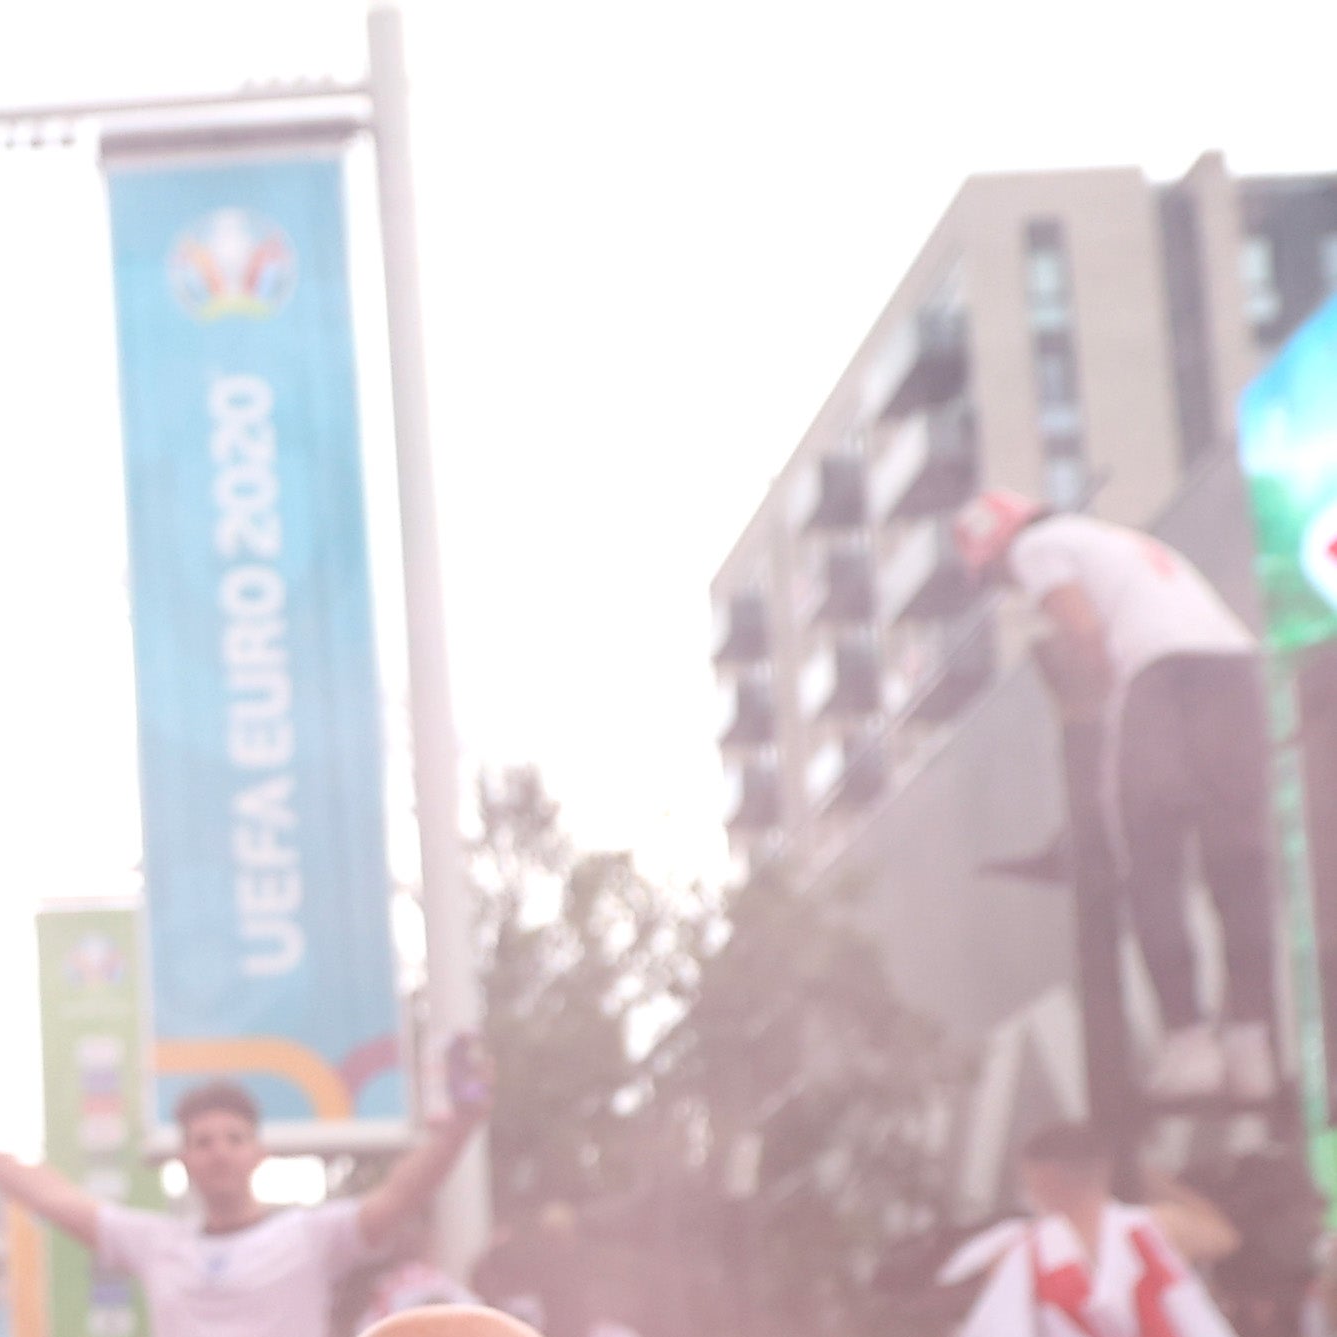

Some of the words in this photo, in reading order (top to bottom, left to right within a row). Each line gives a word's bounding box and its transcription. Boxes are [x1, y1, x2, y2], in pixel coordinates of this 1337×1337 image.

[208, 374, 283, 560] 2020
[220, 564, 294, 768] EURO
[231, 774, 306, 976] UEFA
